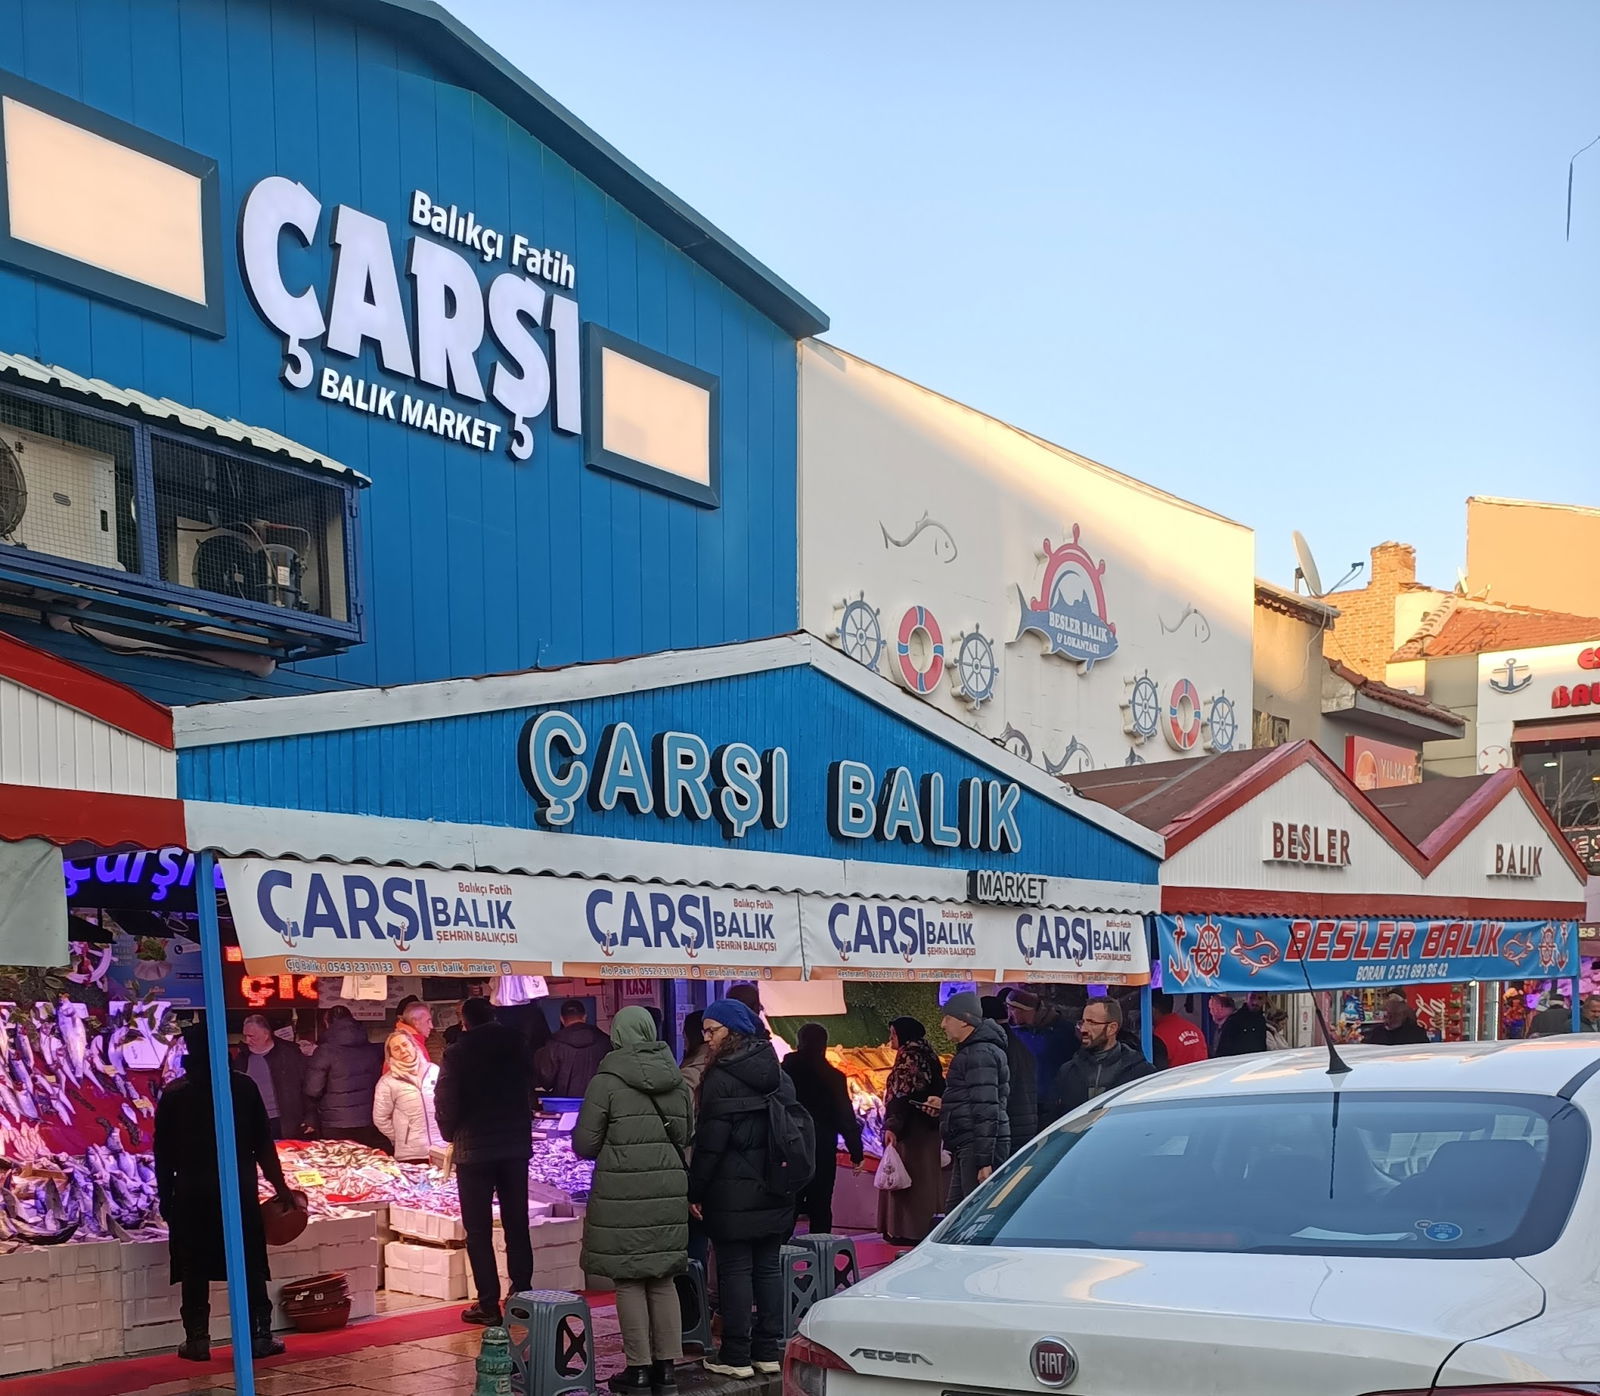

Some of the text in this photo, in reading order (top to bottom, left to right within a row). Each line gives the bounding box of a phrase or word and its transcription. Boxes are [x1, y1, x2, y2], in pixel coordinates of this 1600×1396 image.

[411, 189, 575, 290] Balıkçı Fatih
[239, 175, 582, 460] ÇARŞI
[320, 367, 501, 452] BALIK MARKET
[1049, 611, 1108, 643] BESLER BALIK
[522, 710, 1022, 854] ÇARŞI BALIK
[1272, 821, 1352, 865] BESLER
[1495, 843, 1543, 876] BALIK
[458, 882, 512, 896] Balıkçı Fatih
[977, 871, 1048, 901] MARKET
[431, 896, 516, 929] BALIK
[713, 911, 776, 939] BALIK
[474, 931, 518, 945] BALIKÇISI
[926, 921, 975, 945] BALIK
[1093, 930, 1131, 952] BALIK
[1283, 918, 1504, 963] BESLER BALIK
[327, 962, 352, 972] 0543
[1356, 965, 1386, 981] BORAN
[626, 979, 653, 996] KASA
[1039, 1351, 1065, 1375] FIAT
